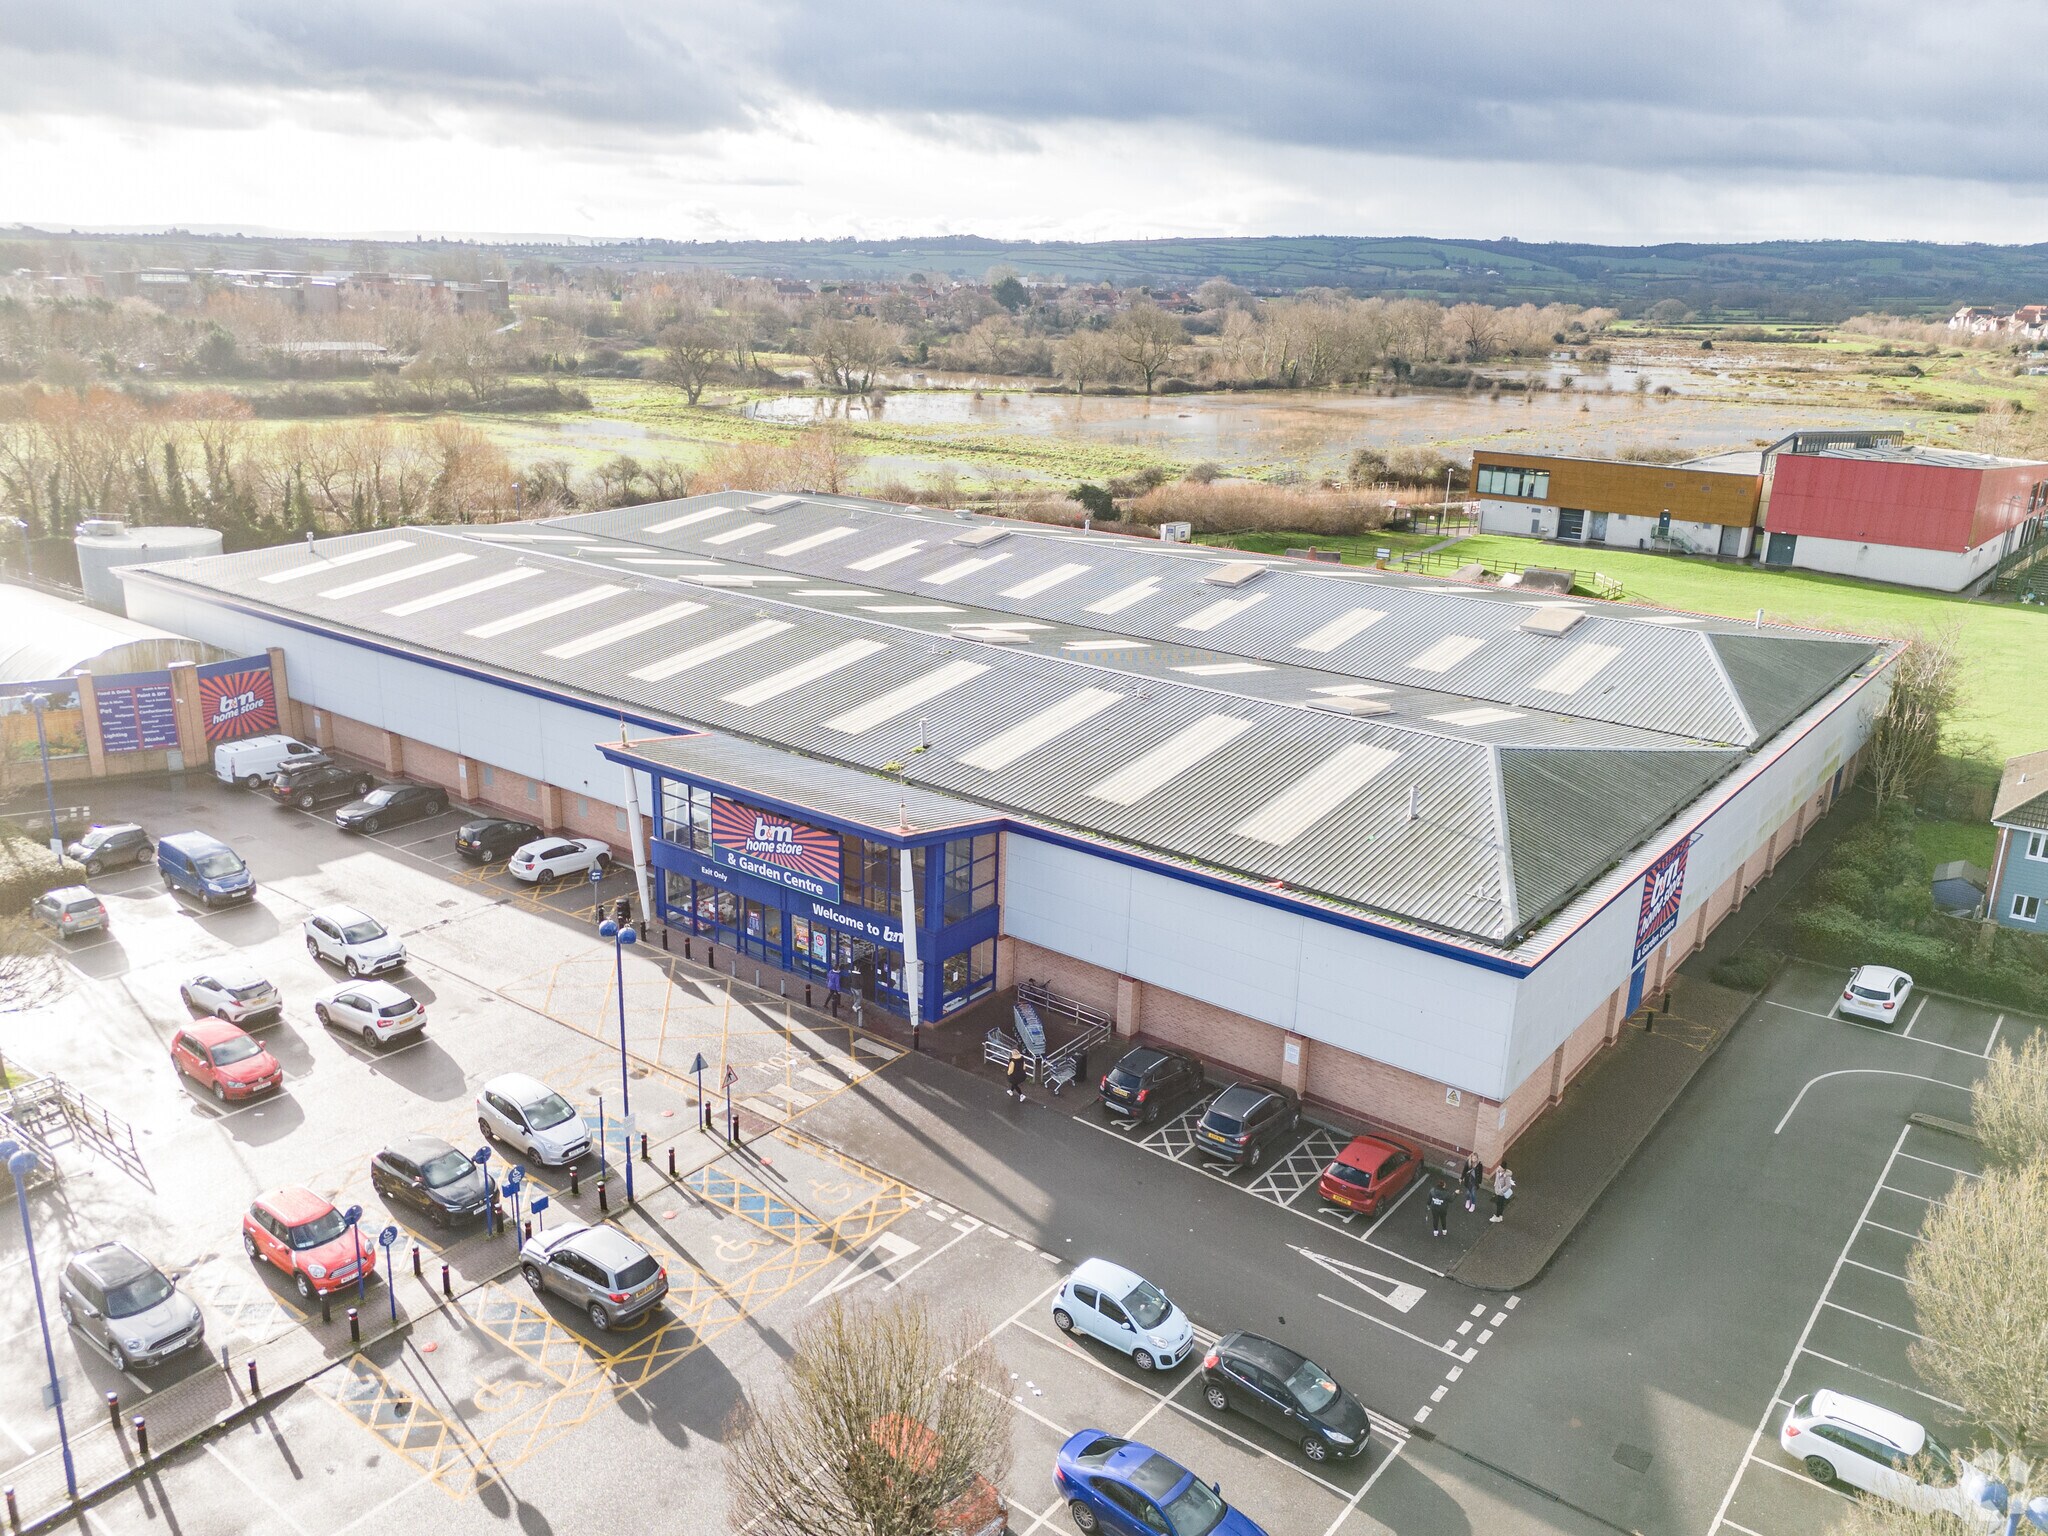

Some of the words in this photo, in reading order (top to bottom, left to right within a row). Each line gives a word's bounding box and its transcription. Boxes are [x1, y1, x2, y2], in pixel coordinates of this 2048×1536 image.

[212, 708, 239, 724] home
[240, 698, 264, 714] store
[745, 837, 774, 852] home
[776, 841, 803, 855] store
[701, 866, 713, 877] Exit
[714, 870, 728, 882] Only
[727, 852, 736, 866] &
[739, 856, 780, 881] Garden
[783, 871, 823, 895] Centre
[812, 903, 864, 931] Welcome
[866, 922, 880, 936] to
[1641, 934, 1659, 955] Garden
[1659, 919, 1675, 938] Centre
